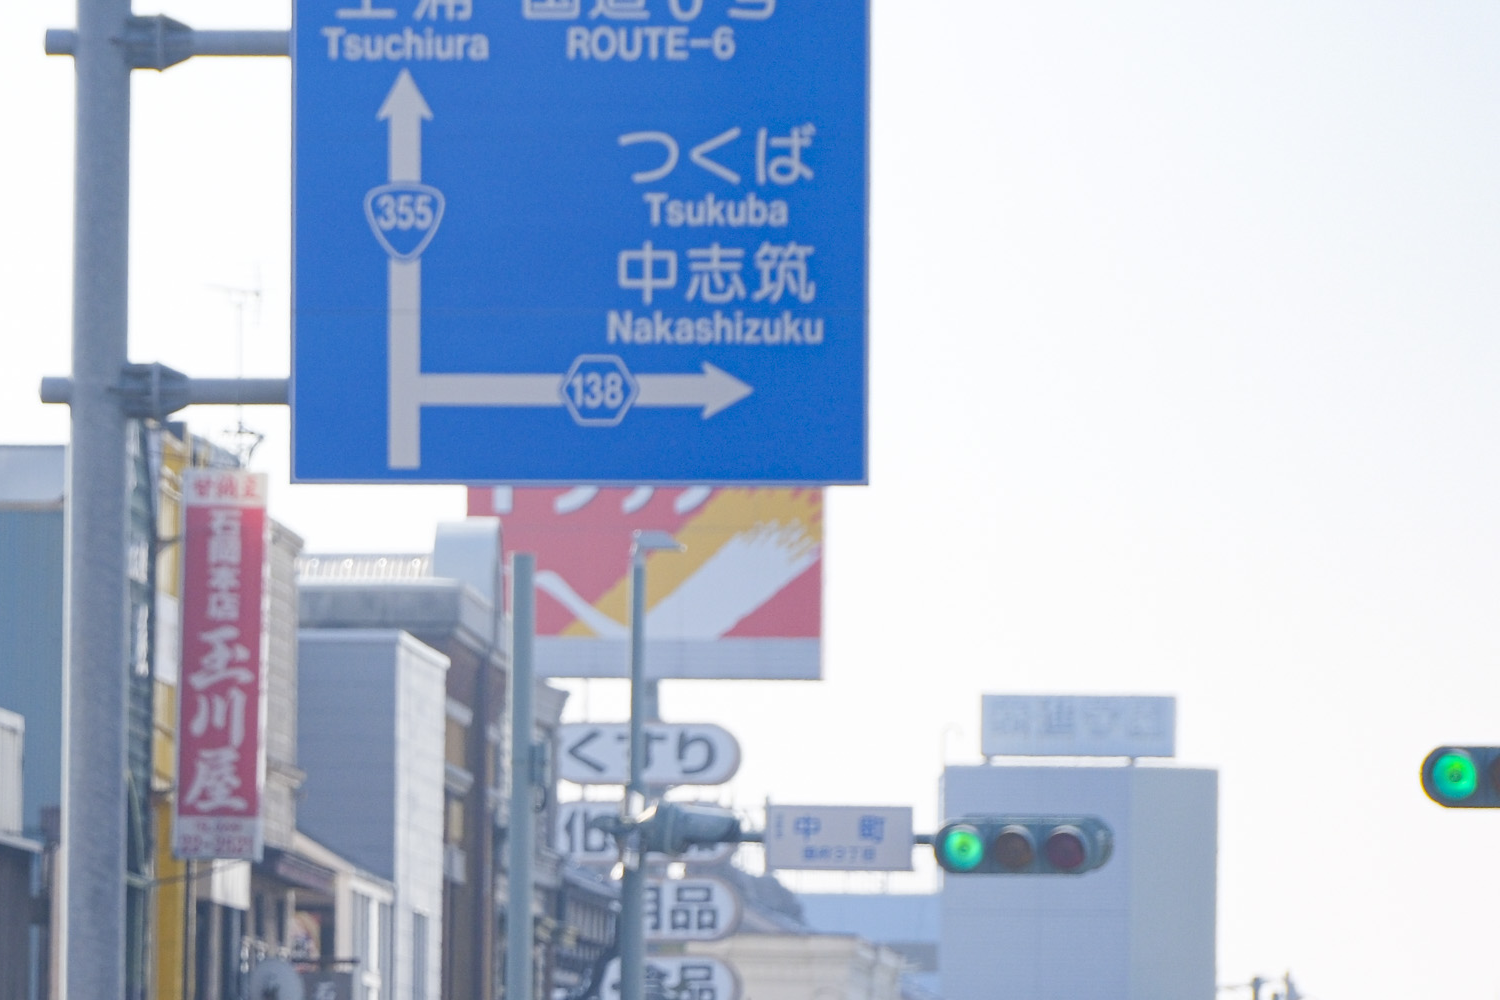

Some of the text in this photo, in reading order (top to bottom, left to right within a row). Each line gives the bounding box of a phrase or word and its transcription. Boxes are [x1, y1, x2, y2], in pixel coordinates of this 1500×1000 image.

[322, 27, 489, 61] Tsuchiura
[566, 27, 736, 61] ROUTE-6
[618, 123, 817, 186] つくば
[377, 195, 432, 230] 355
[644, 193, 788, 227] Tsukuba
[617, 240, 816, 304] 中志筑
[607, 310, 824, 345] Nakashizuku
[570, 372, 624, 408] 138
[185, 625, 255, 812] 玉川屋
[794, 814, 885, 843] 中町
